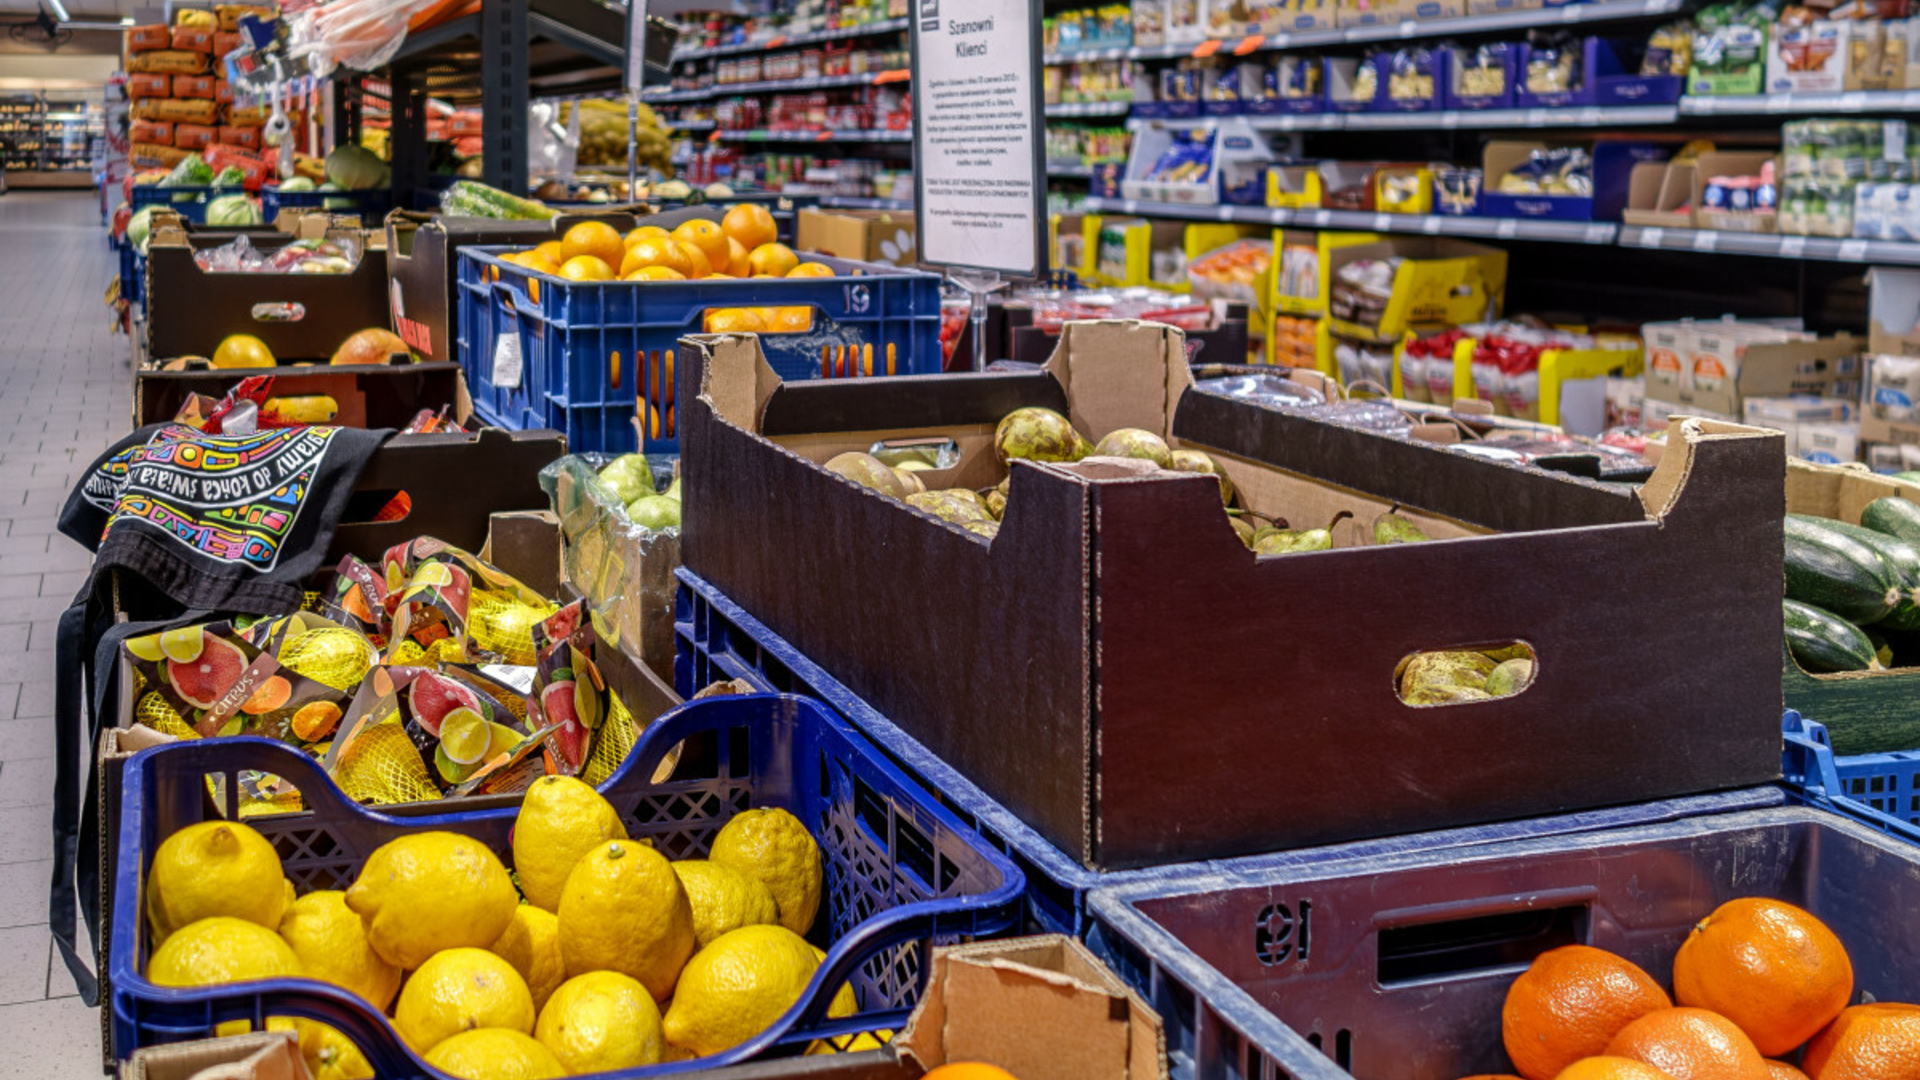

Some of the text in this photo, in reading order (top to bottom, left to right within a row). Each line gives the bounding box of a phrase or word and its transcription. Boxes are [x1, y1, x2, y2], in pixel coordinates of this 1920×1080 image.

[948, 15, 994, 35] Szanowni
[956, 40, 987, 58] Klienci
[276, 434, 324, 476] gramy
[214, 675, 254, 715] CITRUS
